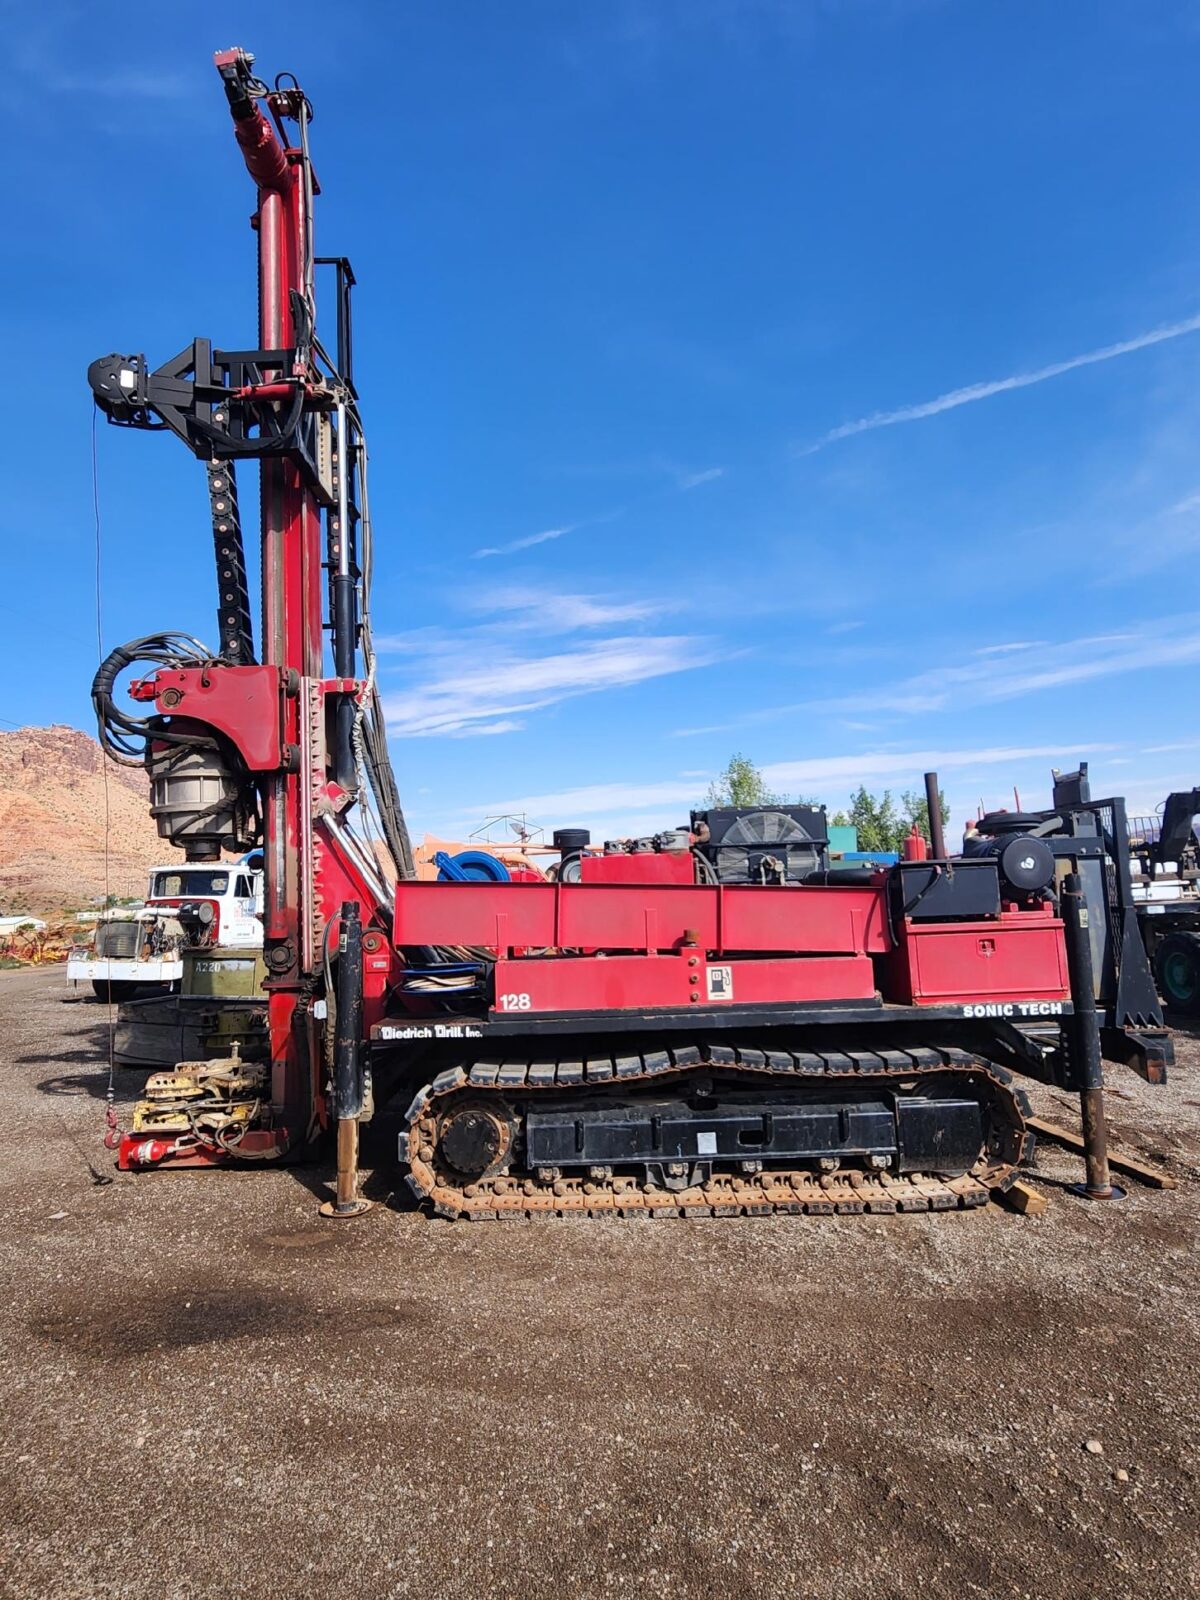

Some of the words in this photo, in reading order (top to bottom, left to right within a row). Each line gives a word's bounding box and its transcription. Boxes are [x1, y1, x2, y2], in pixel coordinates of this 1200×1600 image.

[499, 993, 531, 1011] 128
[963, 1004, 1013, 1017] SONIC
[1018, 1002, 1063, 1016] TECH
[381, 1026, 432, 1040] Diedrich
[465, 1026, 483, 1038] Inc.
